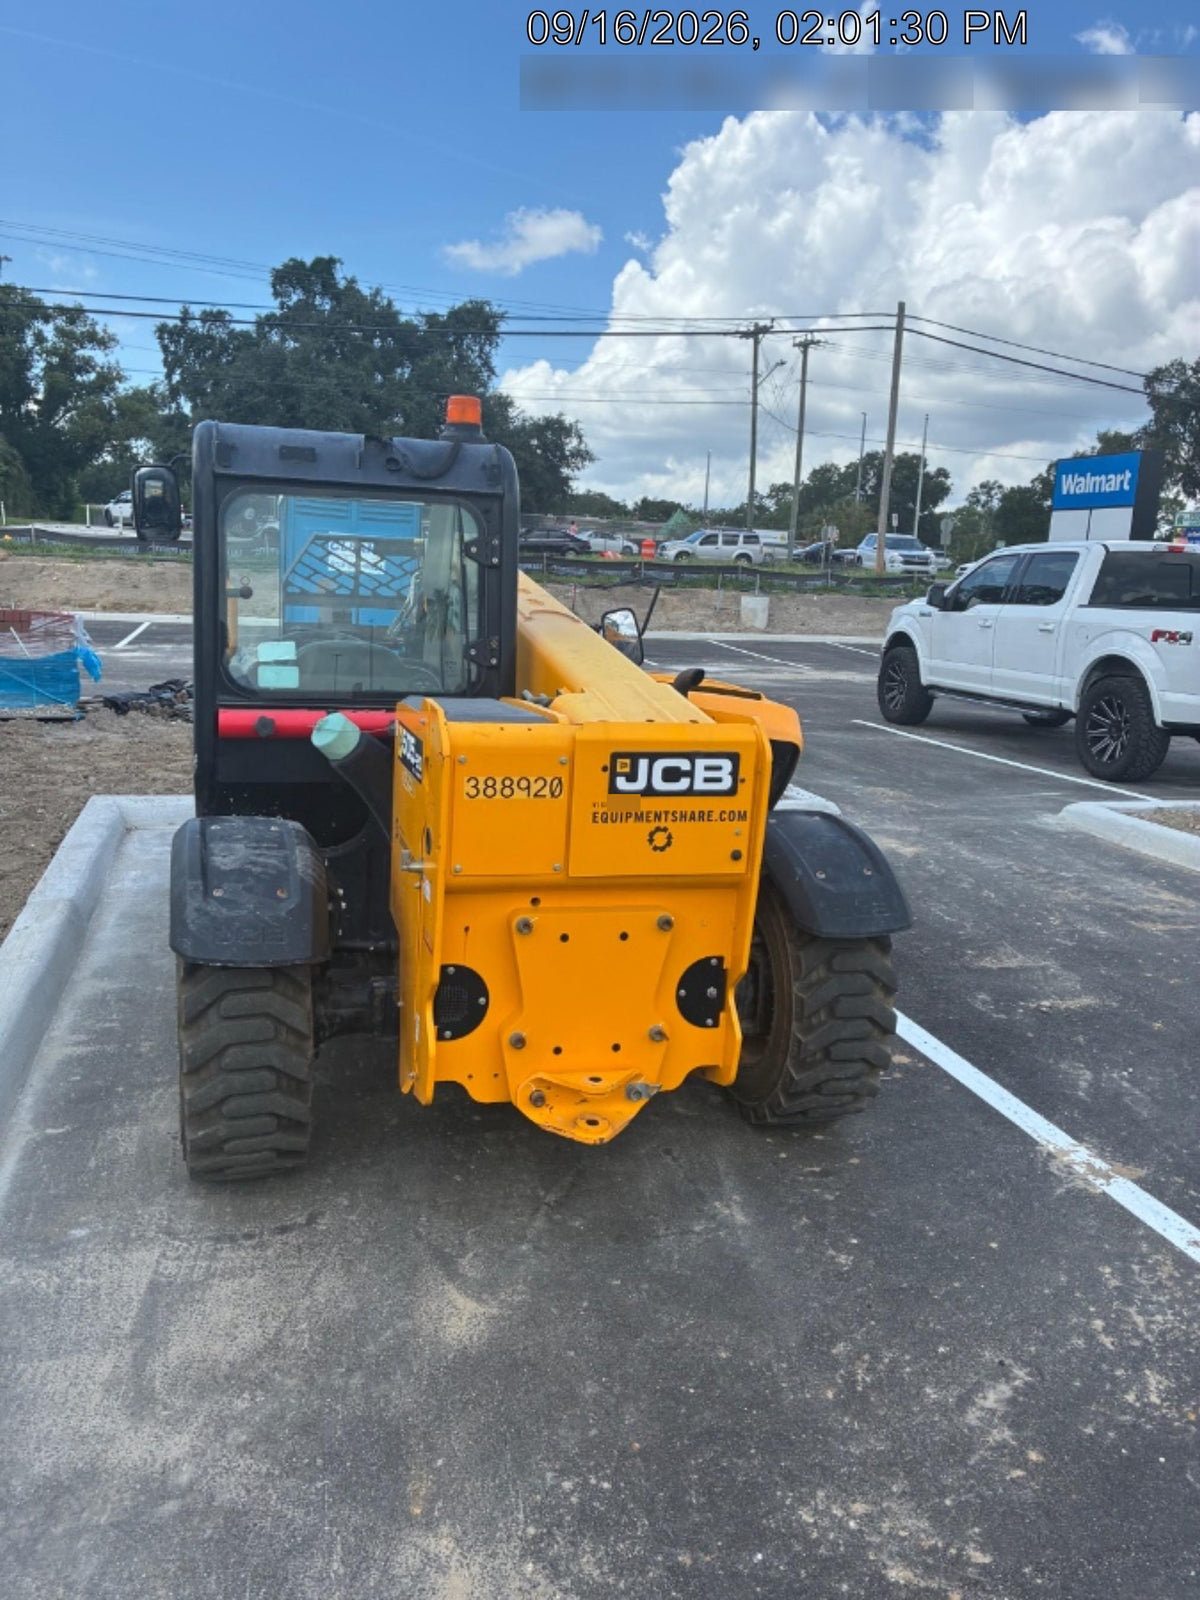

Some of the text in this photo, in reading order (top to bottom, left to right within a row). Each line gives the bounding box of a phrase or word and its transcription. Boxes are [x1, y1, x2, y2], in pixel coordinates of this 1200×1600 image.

[1061, 469, 1132, 495] Walmart
[615, 758, 734, 792] JCB
[465, 776, 563, 799] 388920
[591, 810, 748, 825] EQUIPMENTSHARE.COM
